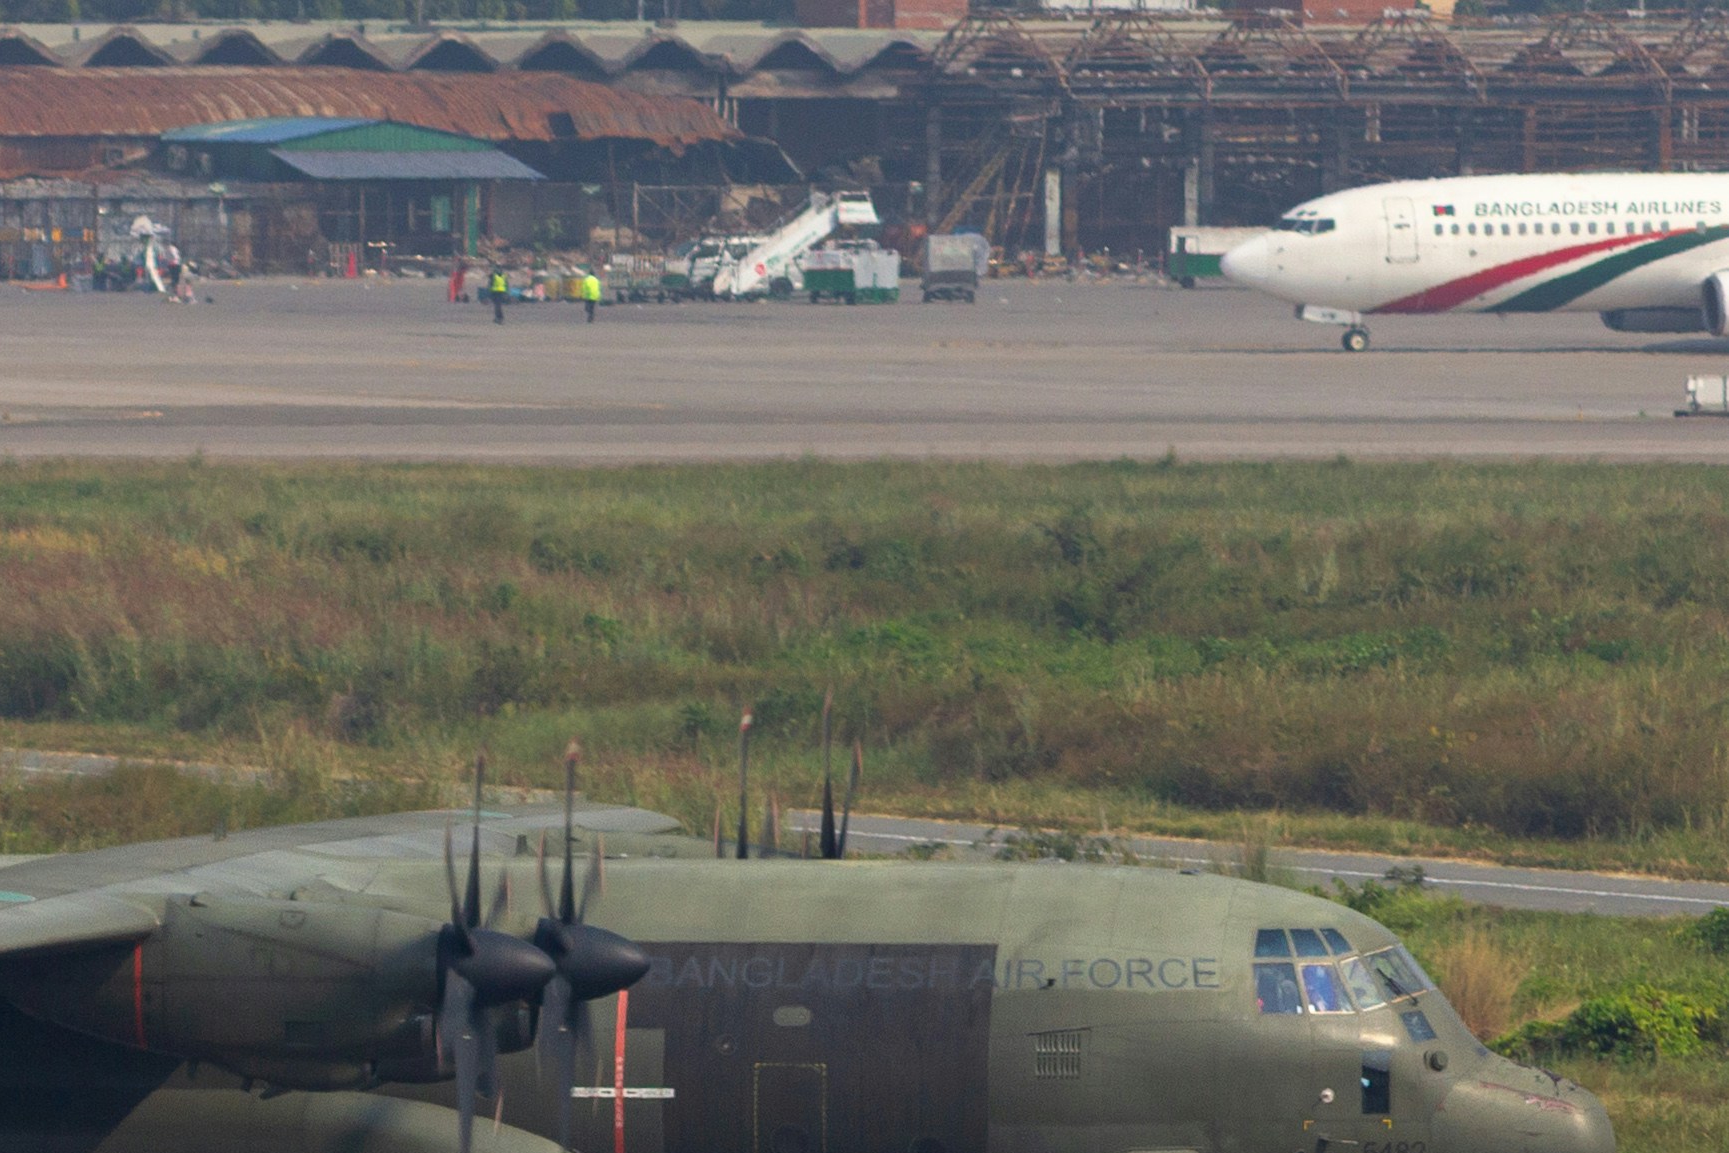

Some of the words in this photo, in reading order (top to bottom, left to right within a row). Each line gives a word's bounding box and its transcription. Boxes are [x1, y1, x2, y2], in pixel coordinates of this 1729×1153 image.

[1474, 201, 1619, 217] BANGLADESH
[1625, 200, 1722, 215] AIRLINES
[647, 956, 959, 990] BANGLADESH
[968, 957, 1047, 990] AIR
[1061, 957, 1220, 989] FORCE
